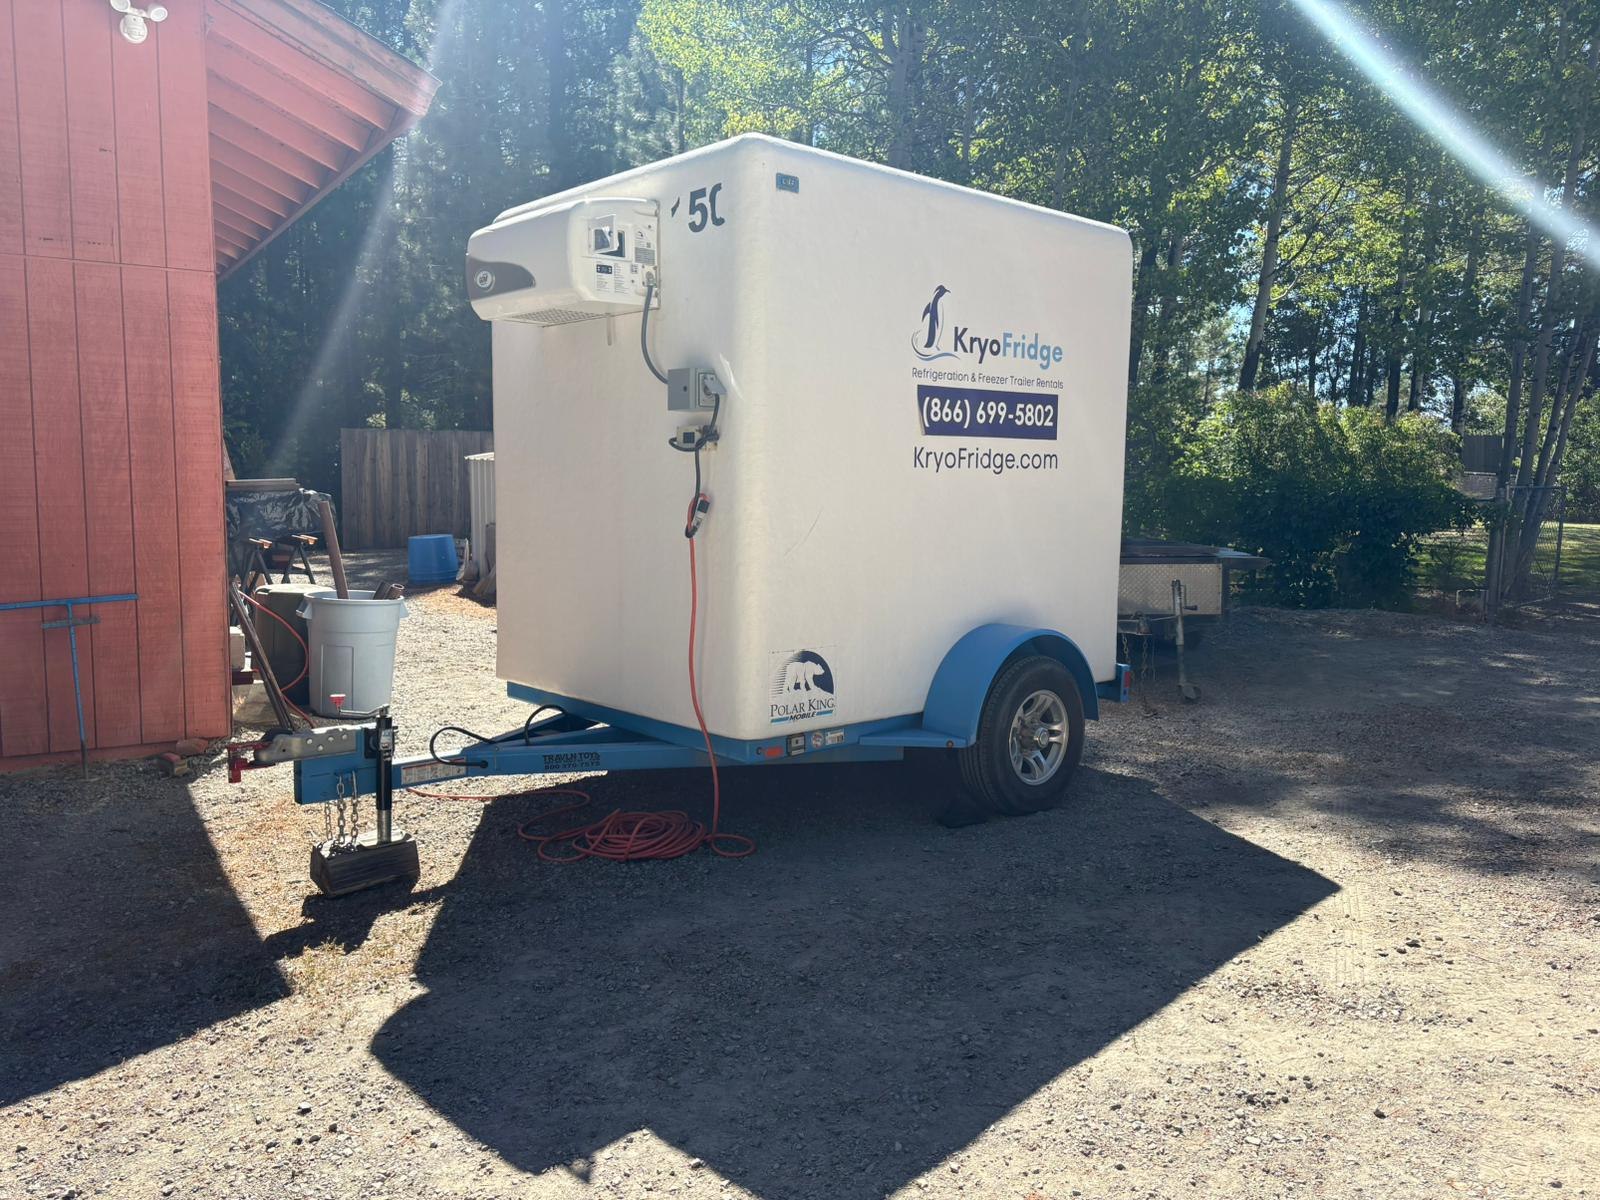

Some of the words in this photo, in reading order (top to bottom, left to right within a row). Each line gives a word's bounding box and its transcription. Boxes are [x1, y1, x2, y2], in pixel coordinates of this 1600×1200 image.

[953, 326, 1063, 370] KryoFridge
[912, 367, 969, 382] Refrigeration
[970, 373, 977, 383] &
[978, 372, 1008, 385] Freezer
[1010, 375, 1035, 386] Trailer
[1036, 378, 1064, 389] Rentals
[922, 396, 971, 428] (866)
[976, 401, 1054, 427] 699-5802
[913, 446, 1058, 475] KryoFridge.com
[770, 703, 805, 717] POLAR
[808, 698, 834, 711] KING
[789, 712, 816, 721] MOBILE
